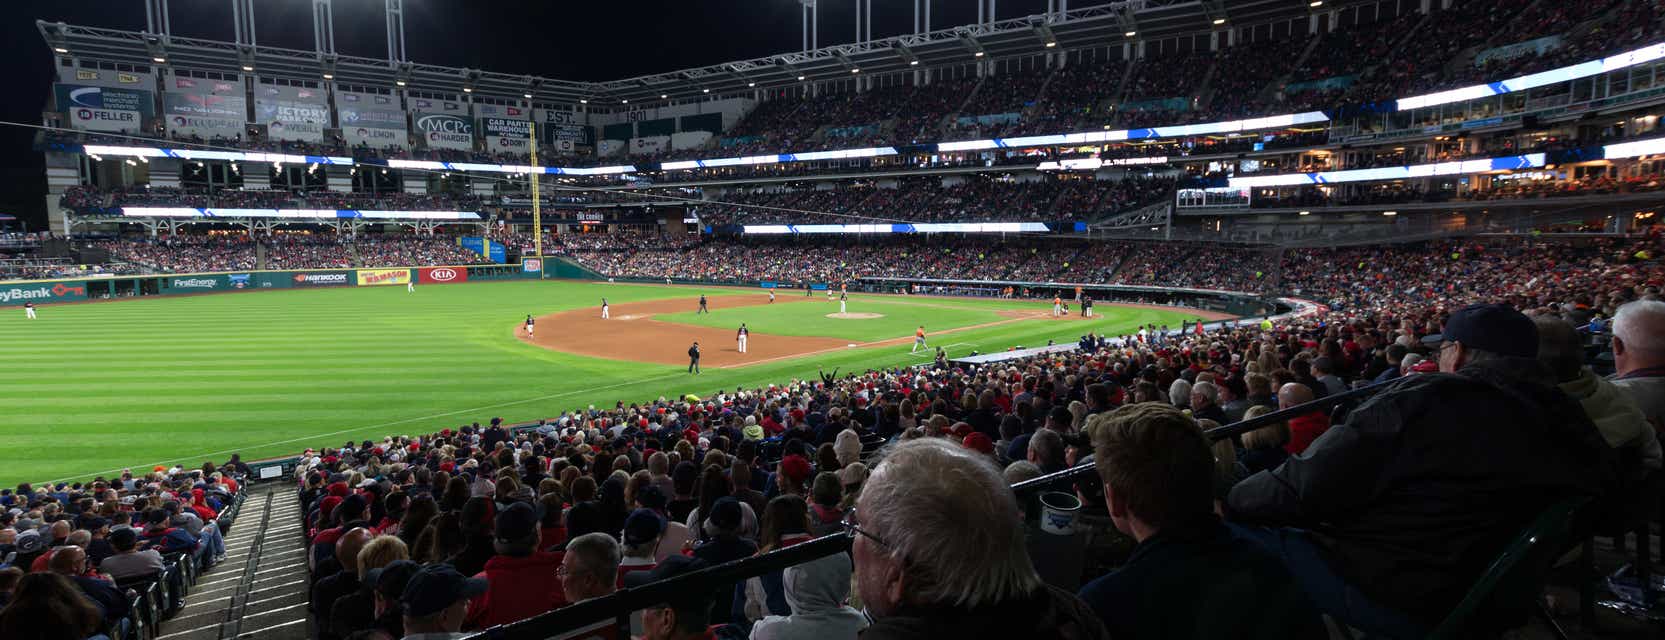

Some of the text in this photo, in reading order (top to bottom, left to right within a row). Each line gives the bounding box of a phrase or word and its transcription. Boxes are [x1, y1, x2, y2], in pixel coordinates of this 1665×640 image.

[94, 112, 134, 121] FELLER
[546, 111, 576, 124] EST.
[626, 110, 647, 121] 1901
[487, 125, 530, 133] WAREHOUS
[368, 130, 396, 140] LEMON
[441, 133, 470, 142] HARDER
[434, 271, 454, 280] KIA
[174, 278, 217, 289] FirstEnergy
